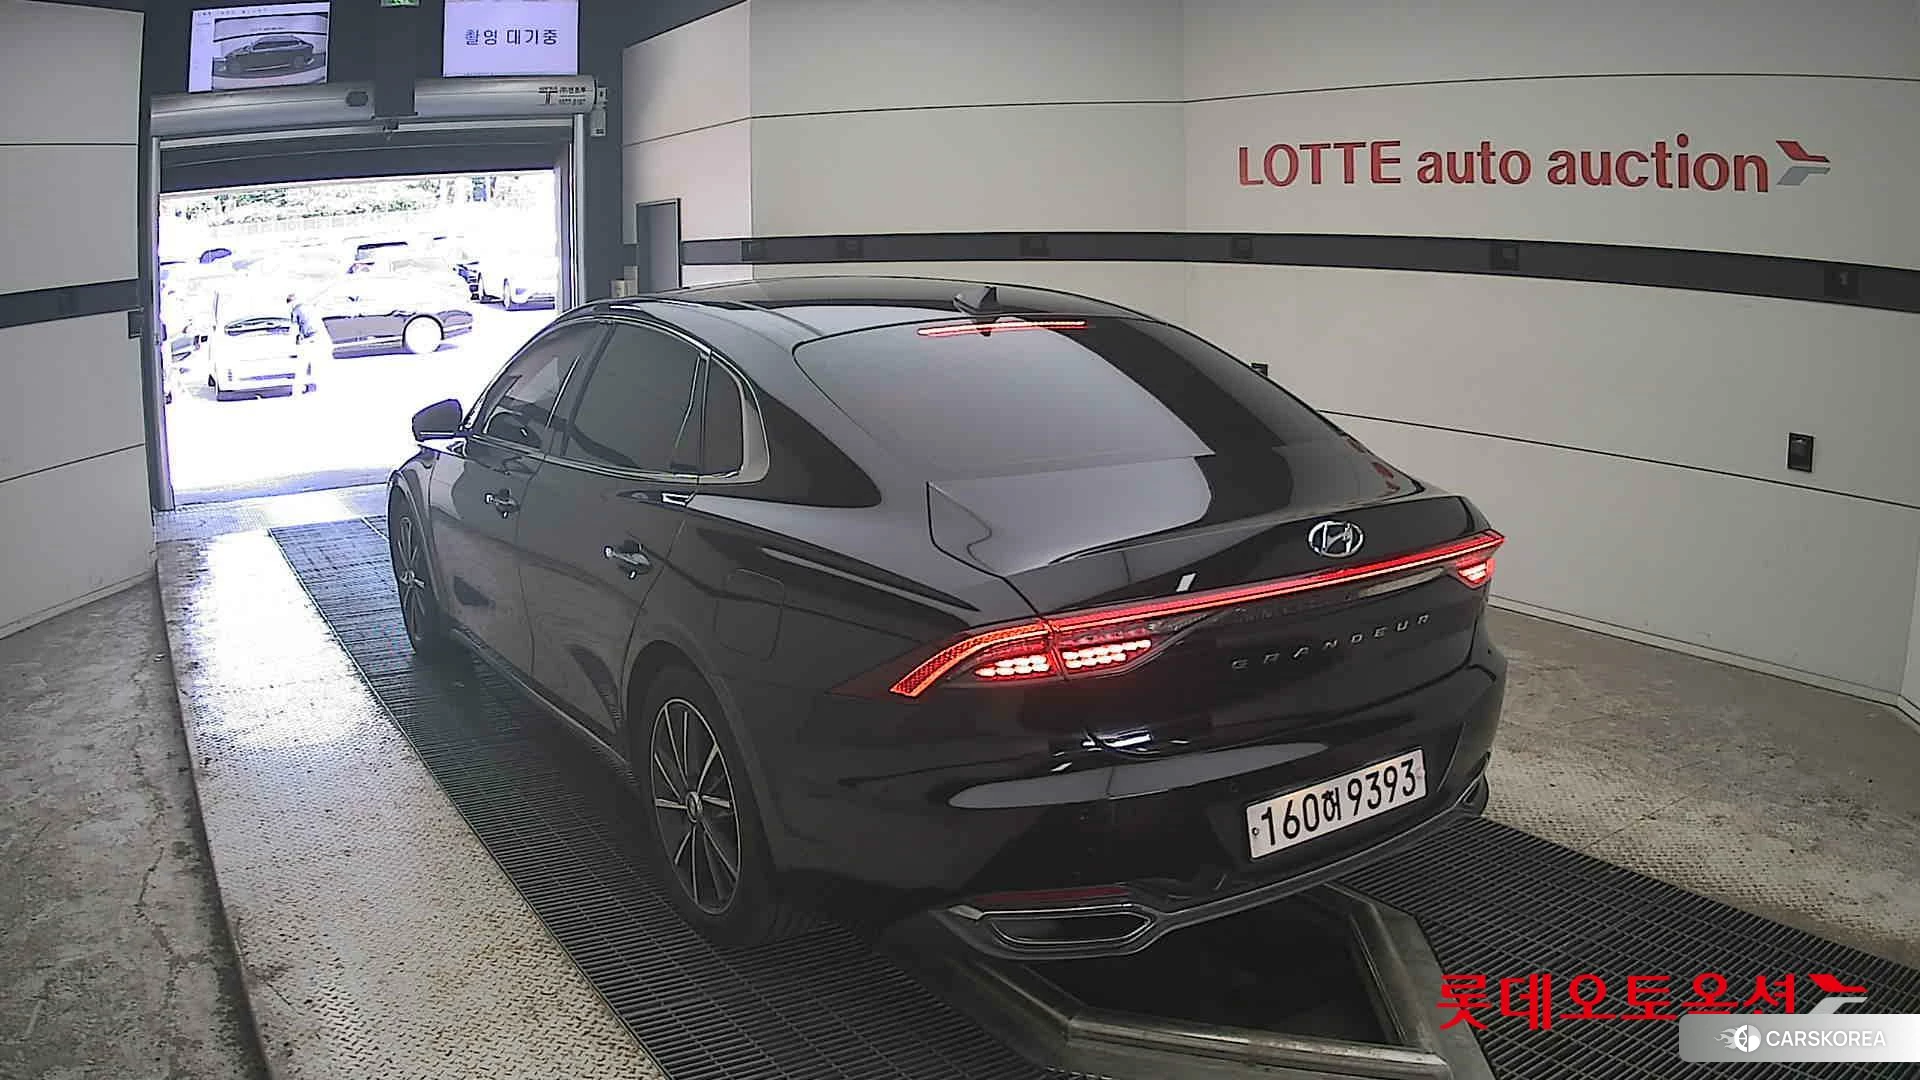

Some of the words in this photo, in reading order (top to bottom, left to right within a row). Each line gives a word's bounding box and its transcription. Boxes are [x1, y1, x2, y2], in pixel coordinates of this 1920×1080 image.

[505, 28, 558, 46] 대기중
[1239, 140, 1402, 187] LOTTE
[1417, 141, 1532, 185] auto
[1547, 133, 1770, 192] auction
[1231, 613, 1430, 669] GRANDEUR
